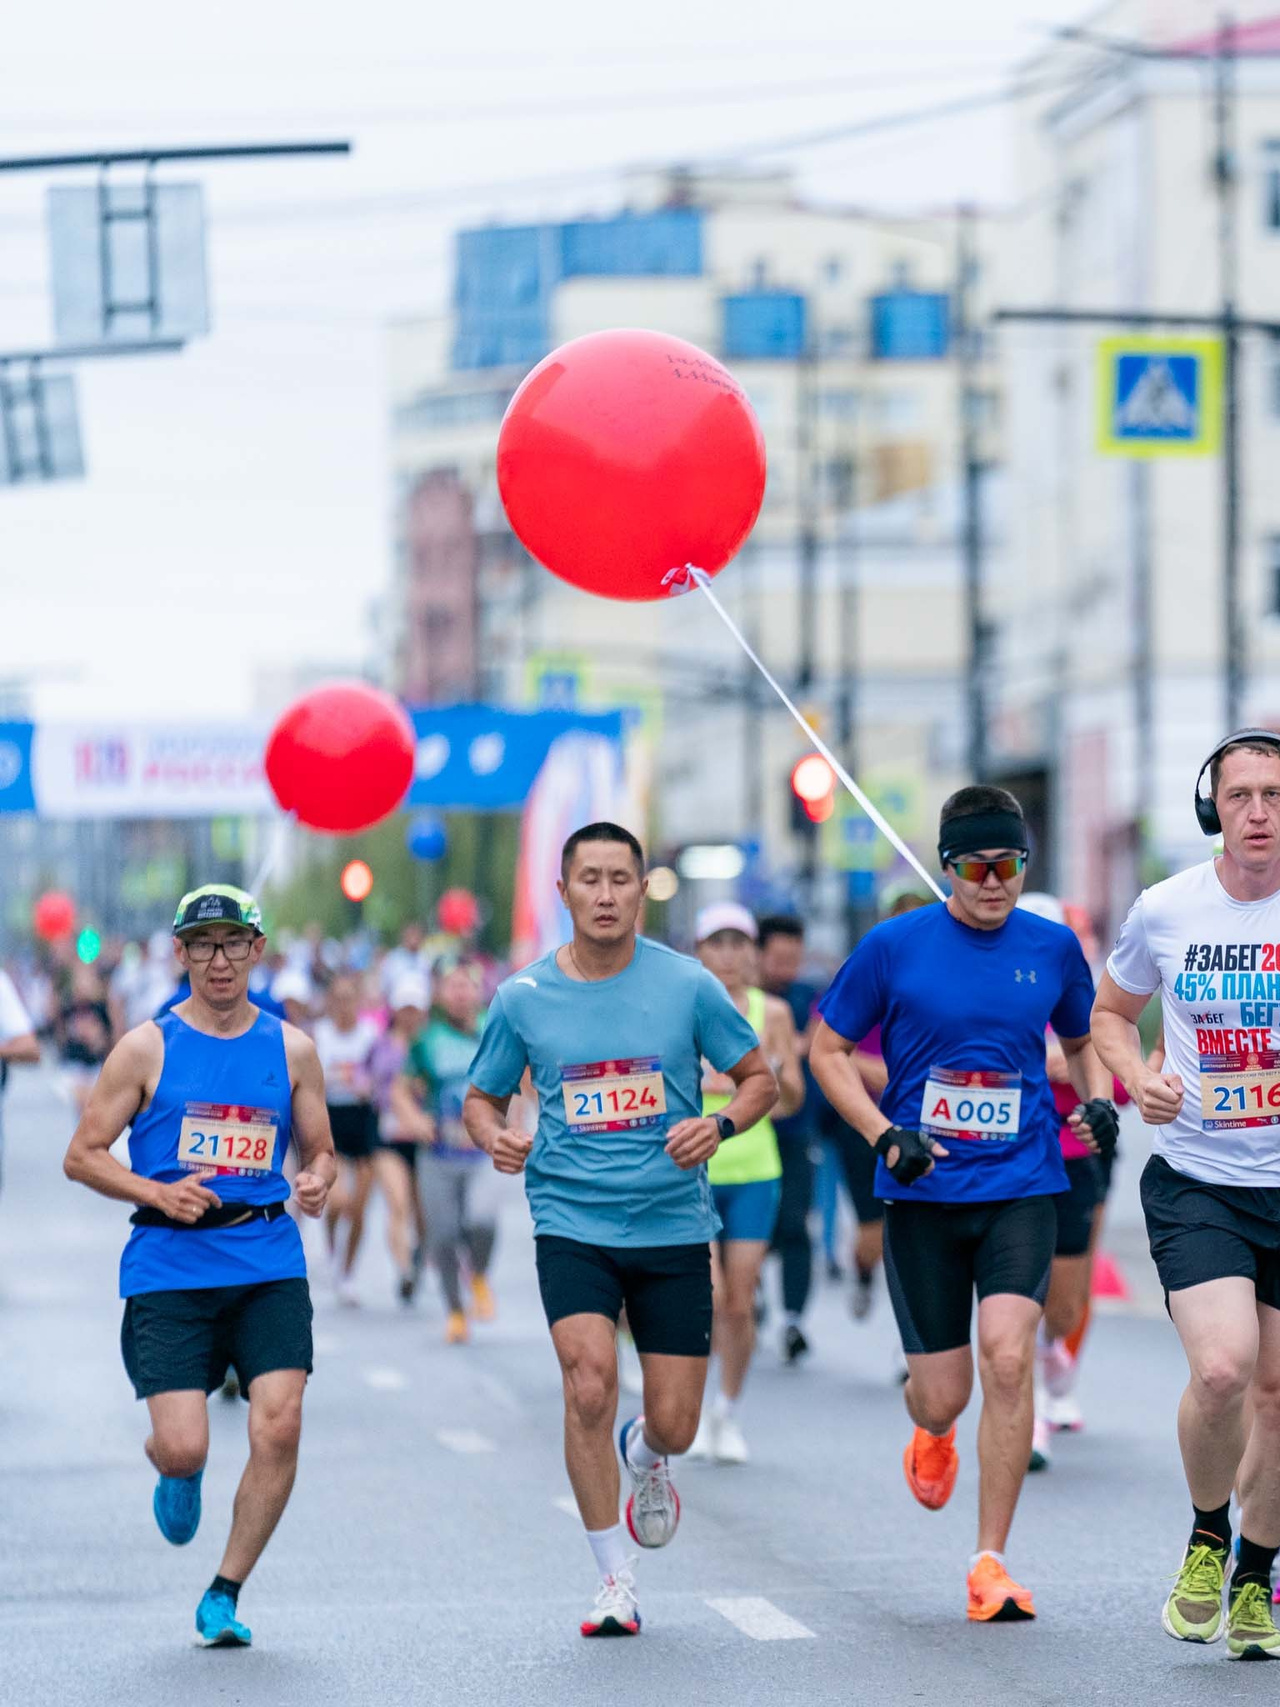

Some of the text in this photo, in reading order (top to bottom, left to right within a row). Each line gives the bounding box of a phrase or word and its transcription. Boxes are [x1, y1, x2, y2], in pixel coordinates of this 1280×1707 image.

[1174, 973, 1217, 1001] 45%
[1196, 1028, 1272, 1054] ВМЕСТЕ
[573, 1086, 658, 1117] 21124
[931, 1097, 1011, 1125] A005
[1214, 1120, 1247, 1129] Skintime
[188, 1131, 268, 1161] 21128
